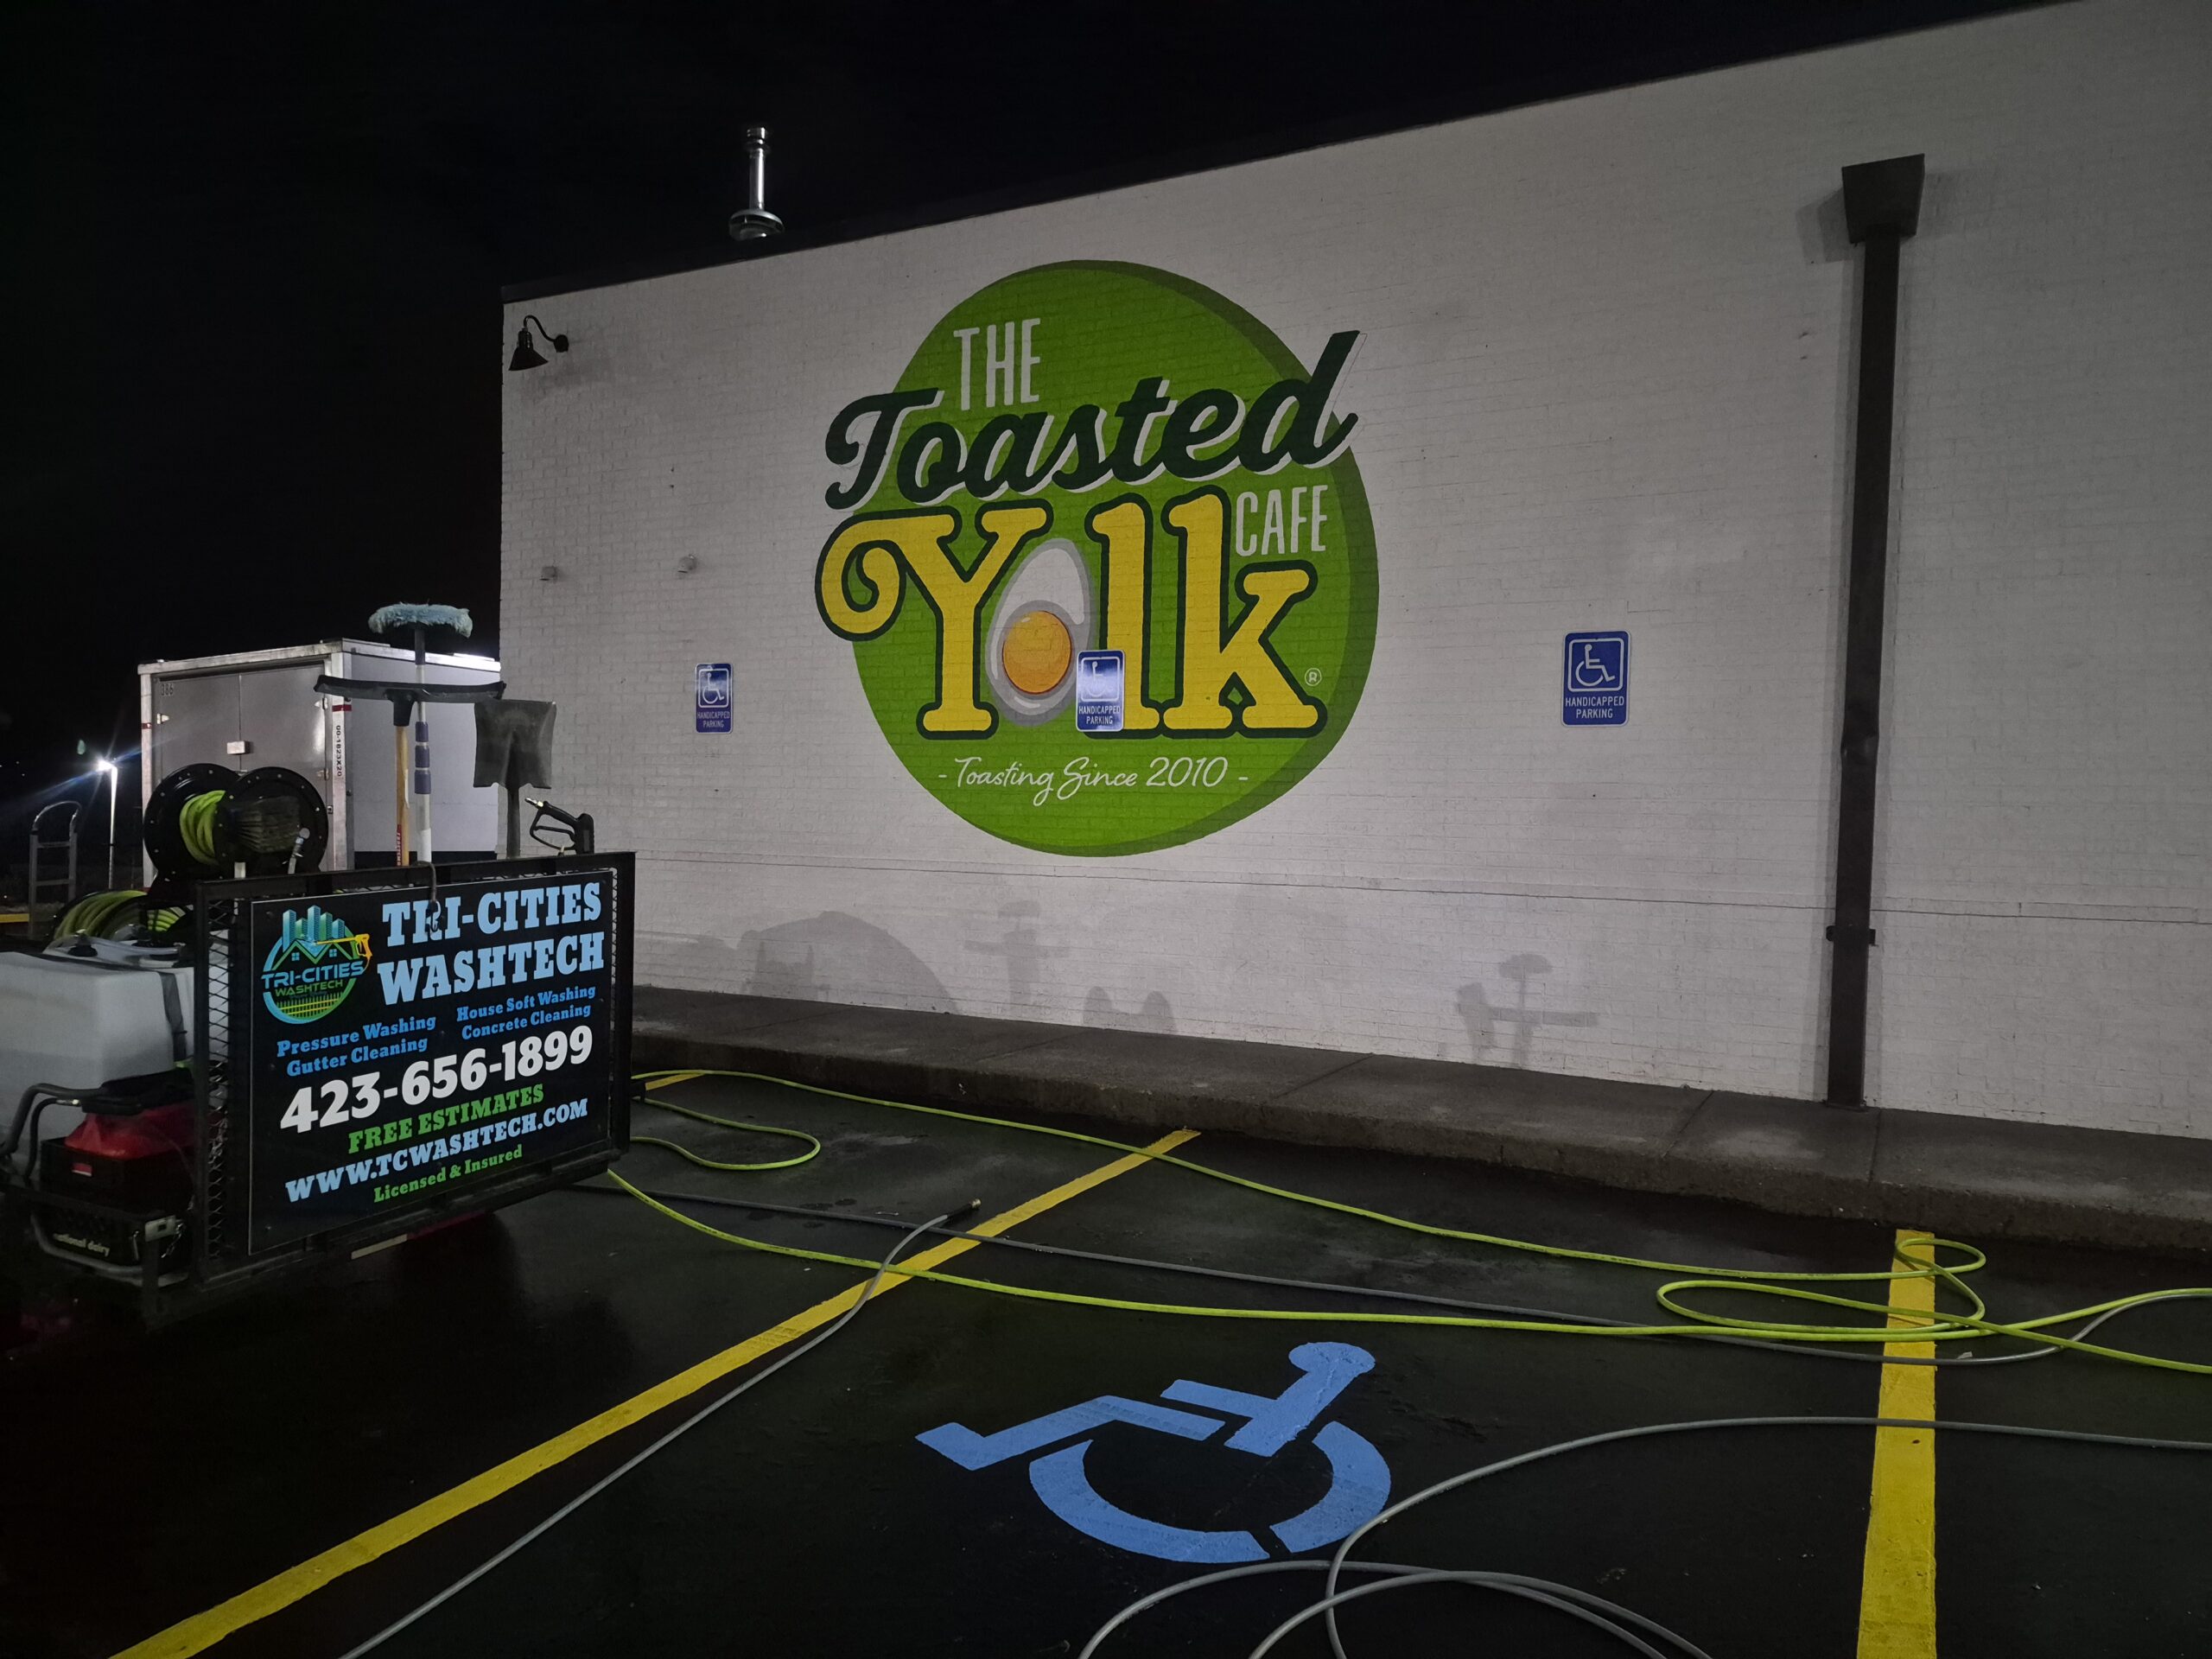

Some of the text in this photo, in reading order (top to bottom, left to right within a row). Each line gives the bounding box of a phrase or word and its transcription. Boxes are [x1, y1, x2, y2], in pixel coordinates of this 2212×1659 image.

[953, 317, 1041, 411] THE
[824, 330, 1363, 512] Toasted
[1236, 485, 1328, 556] CAFE
[814, 485, 1328, 741] Yolk
[696, 710, 730, 719] HANDICAPPED
[1078, 705, 1121, 715] HANDICAPPED
[1086, 715, 1113, 725] PARKING
[1565, 696, 1624, 708] HANDICAPPED
[1575, 709, 1613, 719] PARKING
[702, 720, 725, 728] PARKING
[954, 757, 1054, 807] Toasting
[1056, 757, 1138, 801] Since
[1146, 757, 1229, 788] 2010
[382, 882, 601, 948] TRI-CITIES
[261, 960, 364, 989] TRI-CITIES
[275, 979, 344, 997] WASHTECH
[377, 931, 605, 1006] WASHTECH
[456, 986, 596, 1022] House Soft Washing
[461, 1005, 592, 1040] Concrete Cleaning
[276, 1016, 436, 1058] Pressure Washing
[287, 1038, 429, 1077] Gutter Cleaning
[280, 1025, 594, 1134] 423-656-1899
[348, 1084, 544, 1154] FREE ESTIMATES
[285, 1098, 588, 1203] WWW.TCWASHTECH.COM
[373, 1144, 524, 1204] Licensed & Insured
